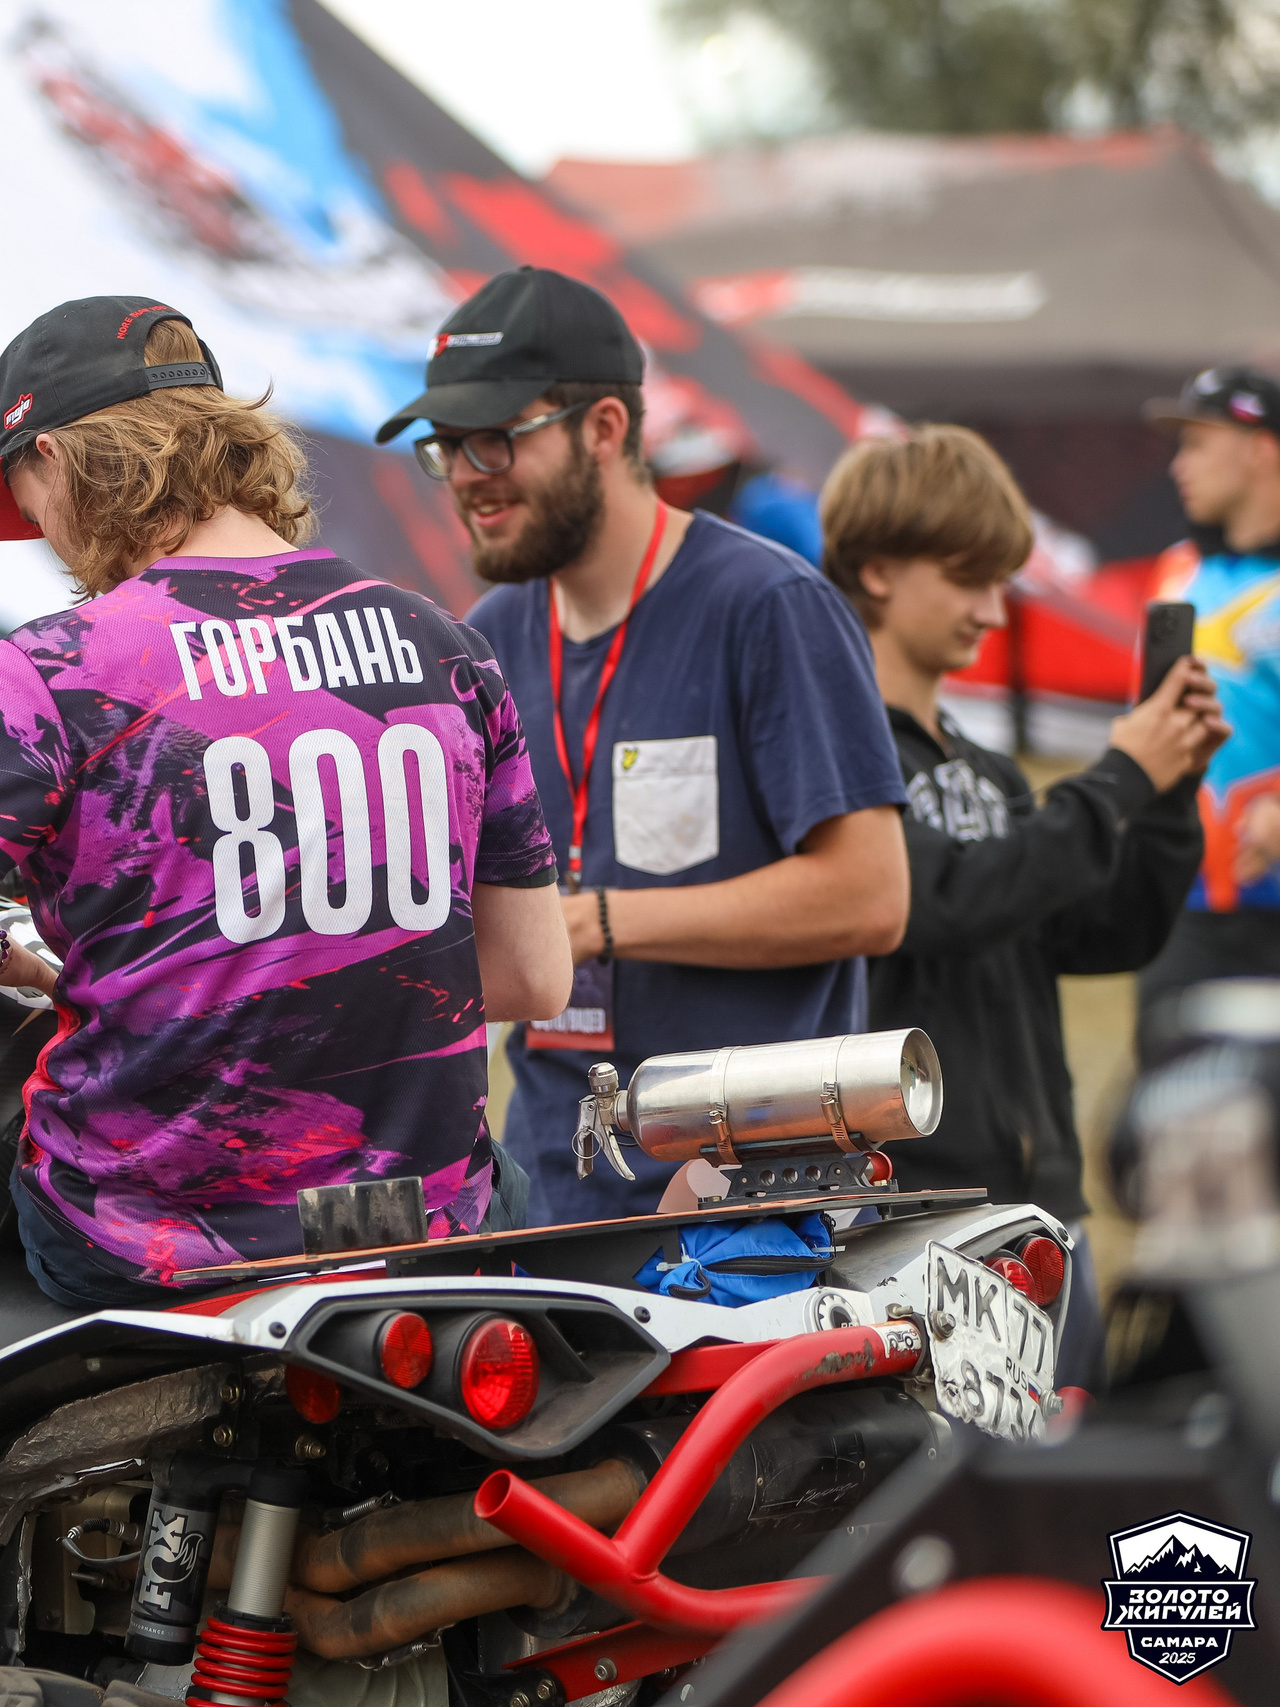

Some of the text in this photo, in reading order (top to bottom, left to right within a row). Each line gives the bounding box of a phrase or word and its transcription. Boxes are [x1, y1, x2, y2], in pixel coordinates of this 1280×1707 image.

[117, 317, 134, 339] MORE
[6, 399, 30, 425] mojo
[169, 607, 424, 701] ГОРБАНЬ
[203, 723, 451, 944] 800
[936, 1256, 1047, 1376] MK 77
[1006, 1356, 1028, 1391] RUS
[138, 1510, 187, 1611] FOX
